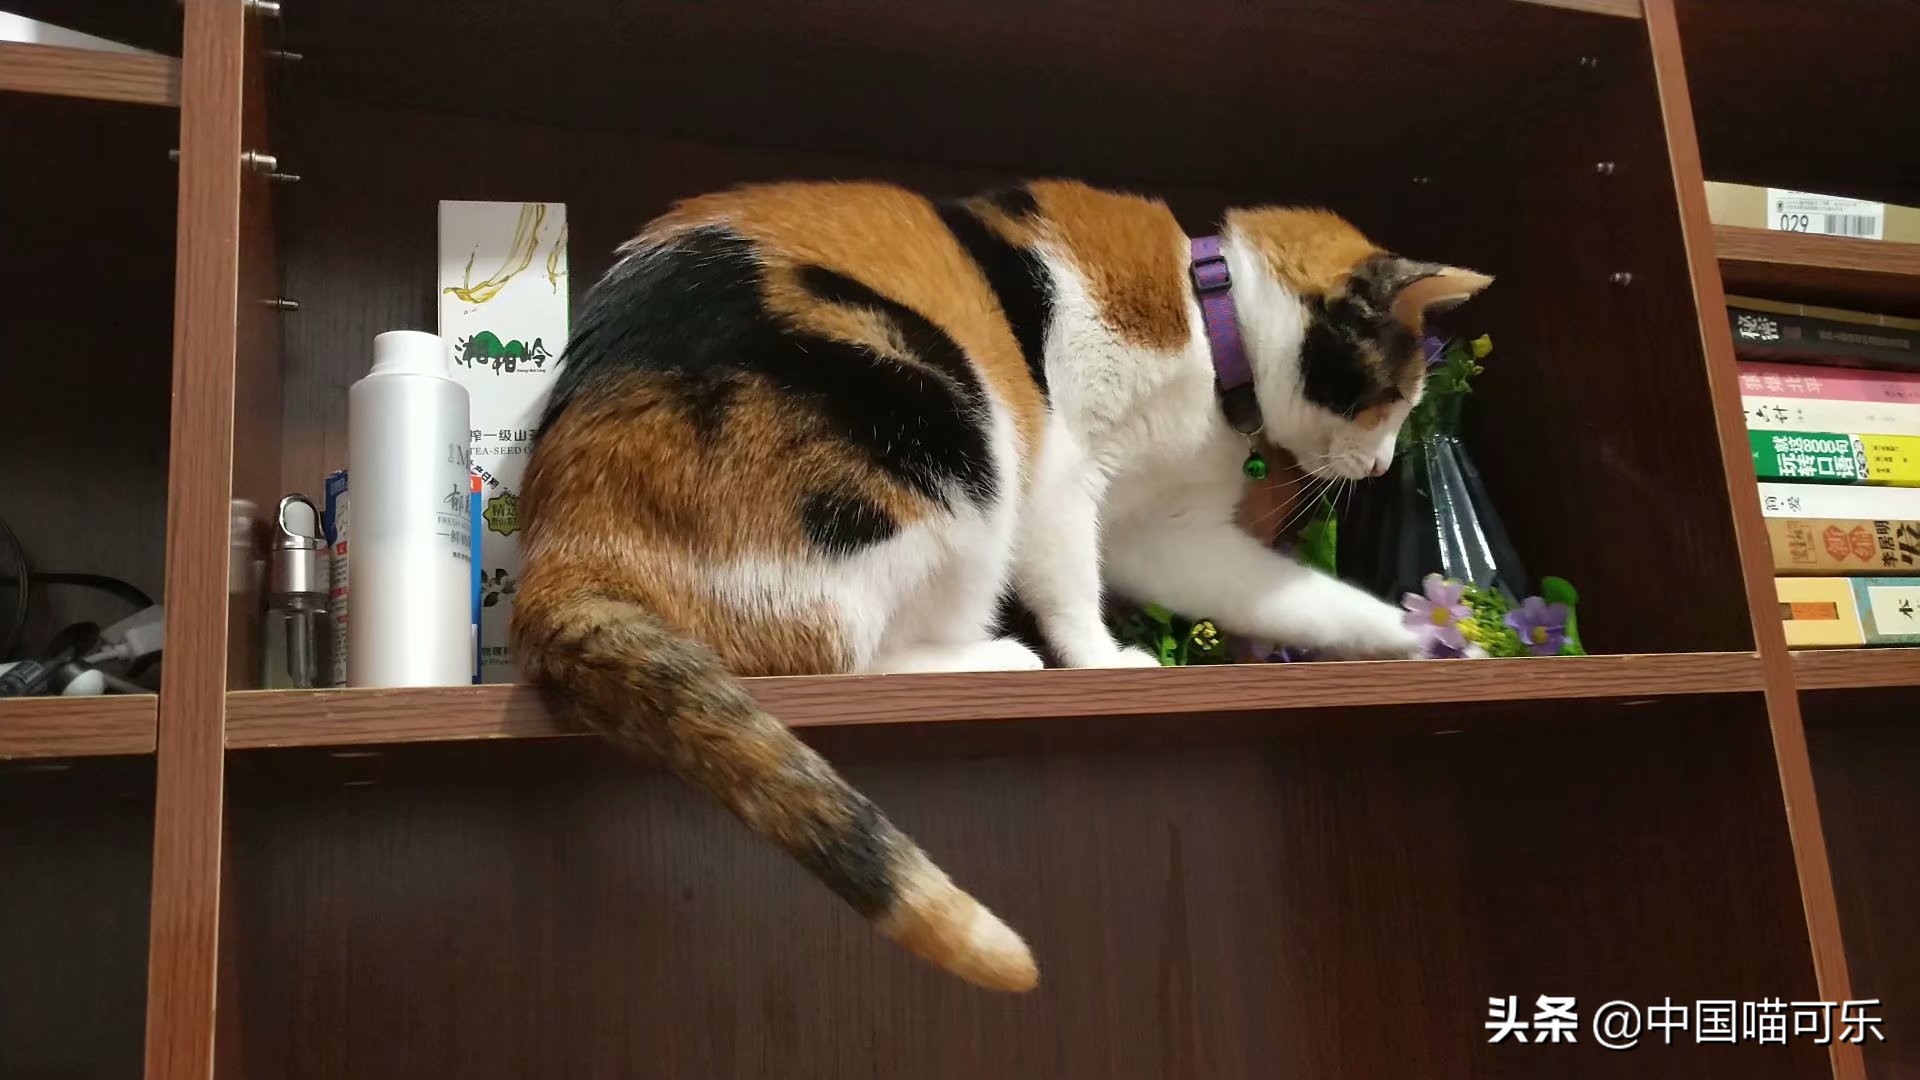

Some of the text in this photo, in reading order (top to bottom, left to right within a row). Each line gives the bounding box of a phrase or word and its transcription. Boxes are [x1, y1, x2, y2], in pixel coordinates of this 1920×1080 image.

[1780, 214, 1809, 232] 029
[1738, 315, 1780, 340] 秘密
[1741, 373, 1824, 393] 狼烟北平
[1772, 435, 1849, 454] 就这8000句
[1777, 453, 1856, 477] 玩转口语
[1874, 521, 1899, 568] 李居明
